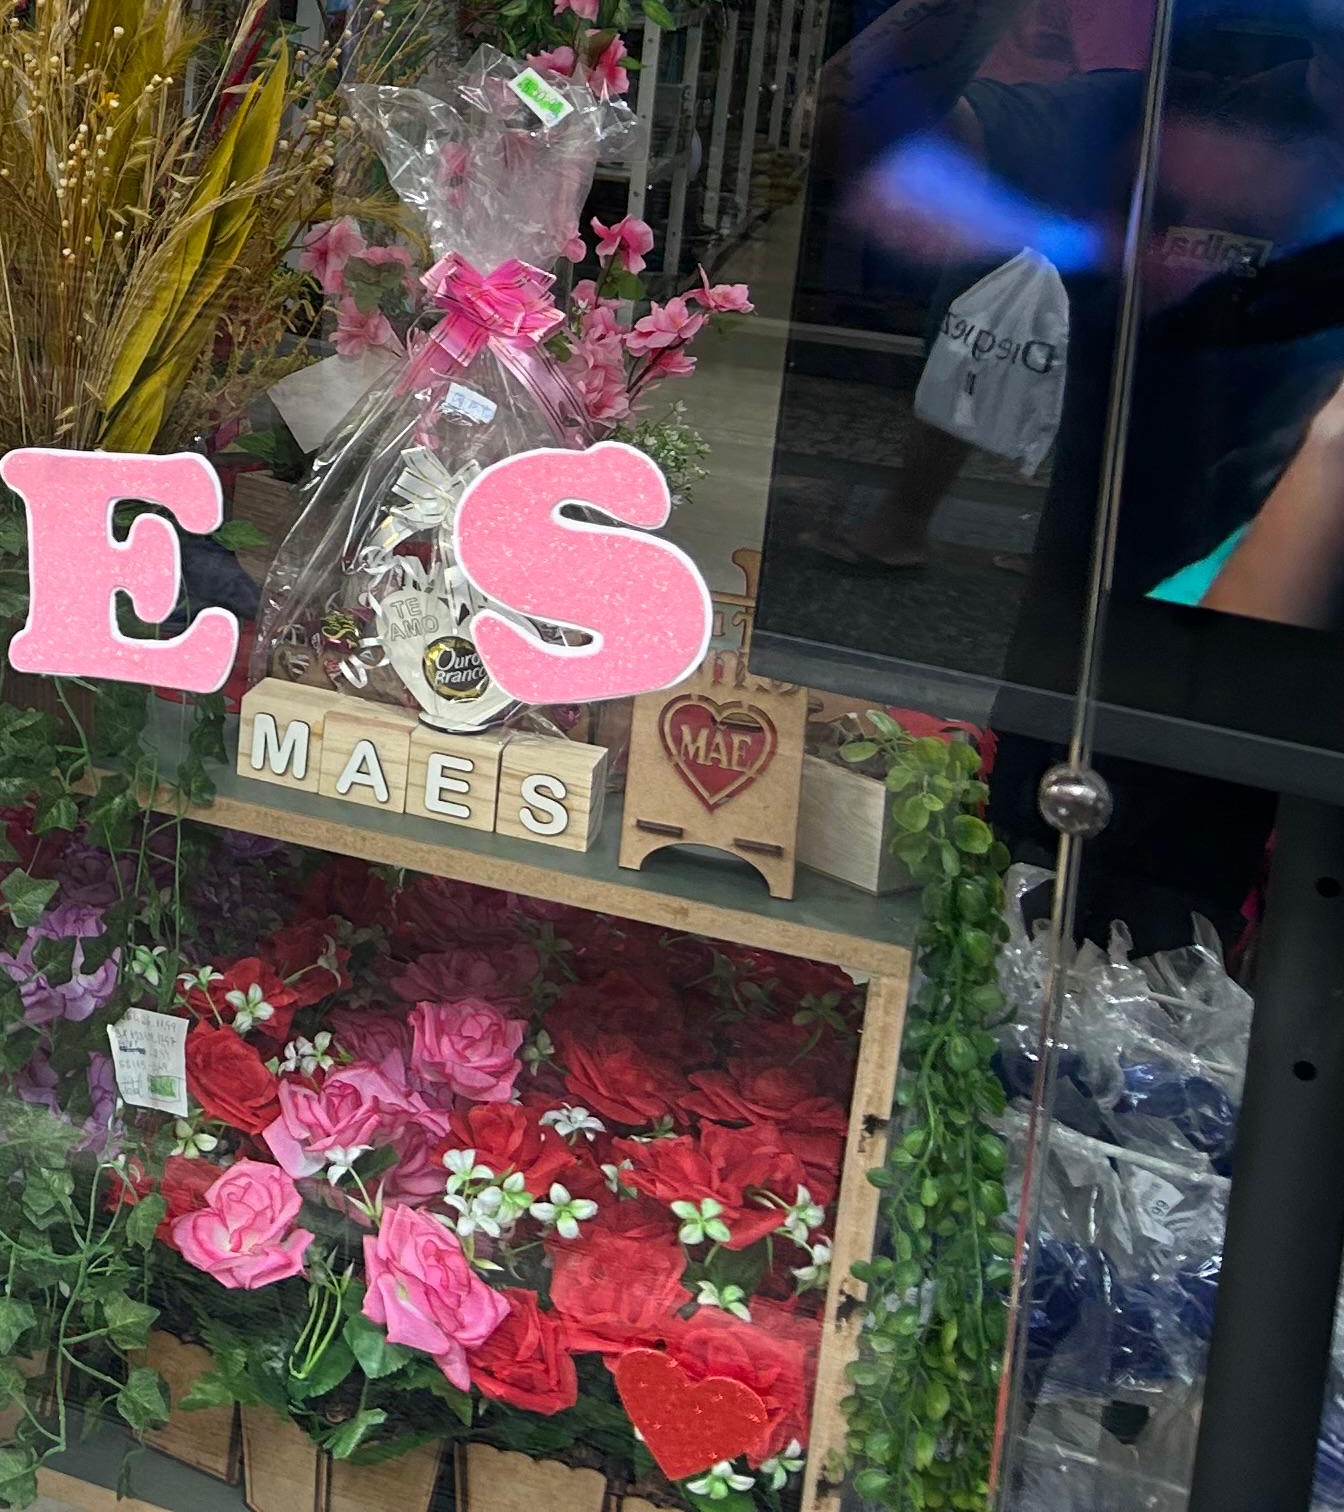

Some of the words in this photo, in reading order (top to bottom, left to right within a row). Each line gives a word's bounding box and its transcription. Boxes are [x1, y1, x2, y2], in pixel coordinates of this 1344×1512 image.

[391, 597, 422, 619] TE
[391, 614, 440, 641] AMO
[436, 648, 482, 670] Ouro
[250, 711, 570, 837] MAES
